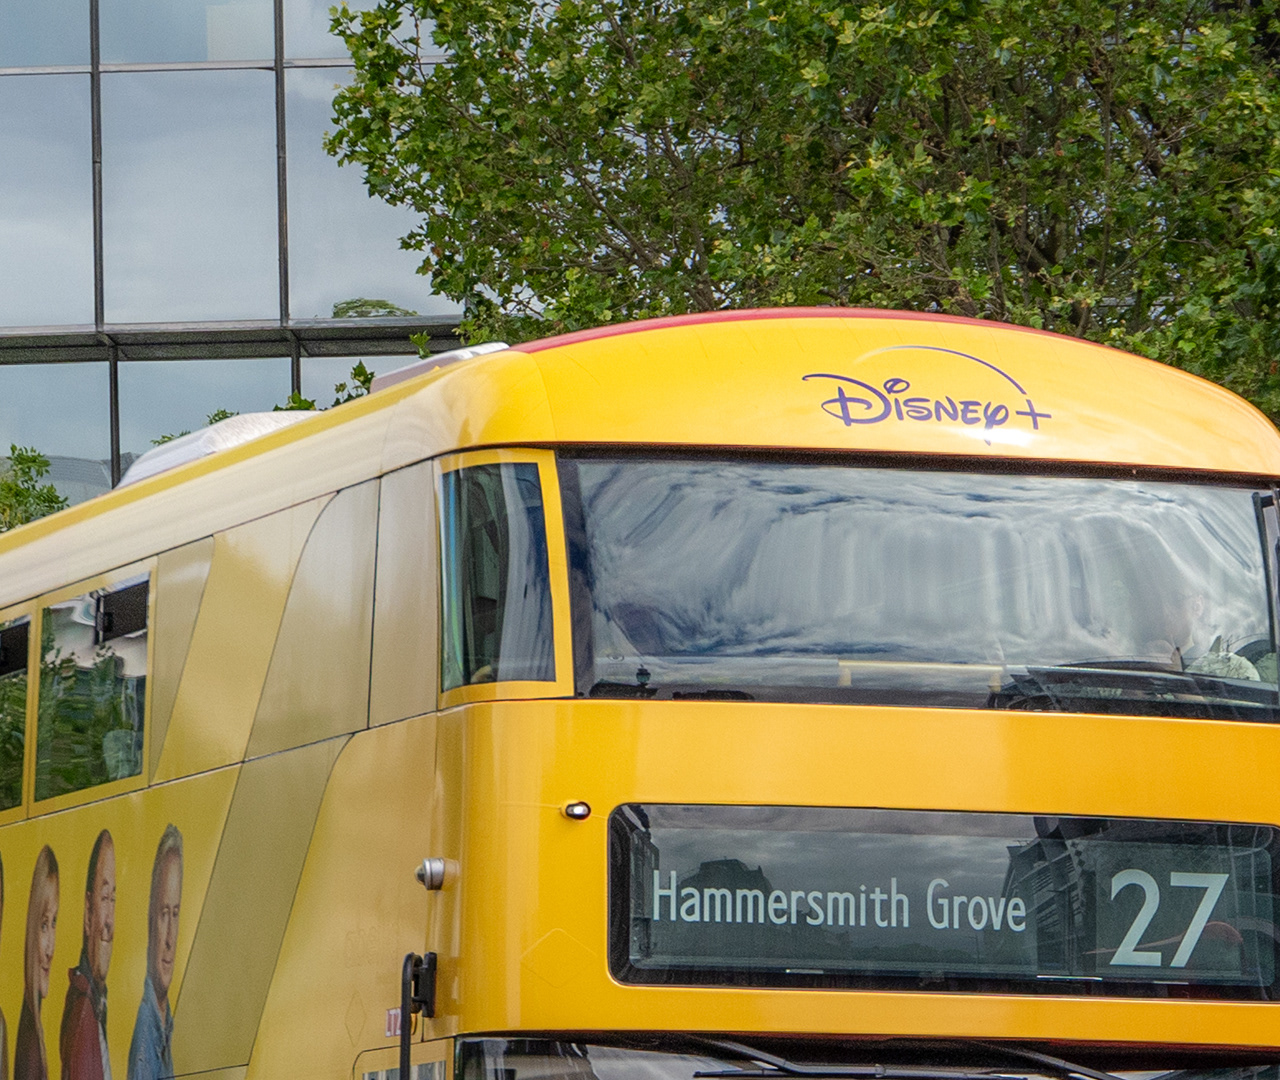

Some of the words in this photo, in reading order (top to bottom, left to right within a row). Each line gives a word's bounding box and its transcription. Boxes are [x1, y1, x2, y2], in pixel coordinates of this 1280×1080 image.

[653, 870, 910, 928] Hammersmith
[926, 878, 1027, 932] Grove
[1110, 869, 1230, 968] 27
